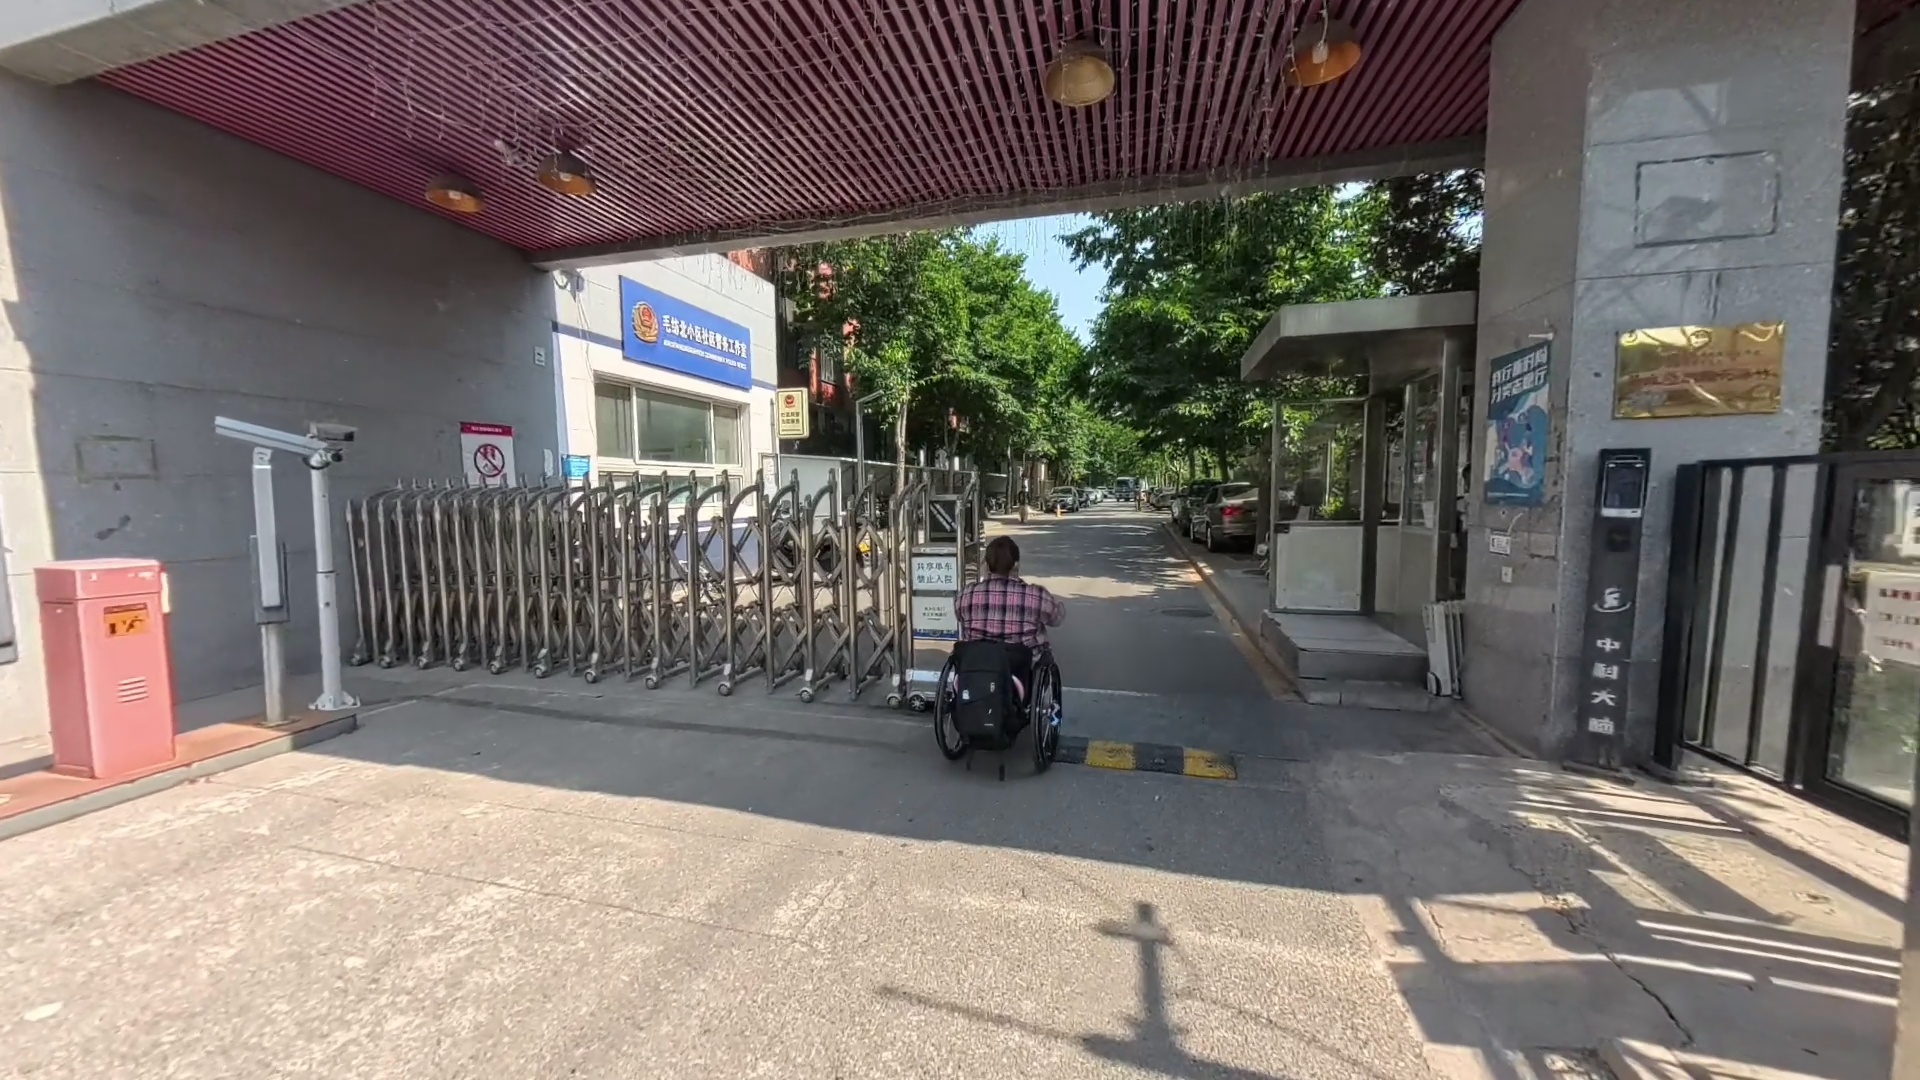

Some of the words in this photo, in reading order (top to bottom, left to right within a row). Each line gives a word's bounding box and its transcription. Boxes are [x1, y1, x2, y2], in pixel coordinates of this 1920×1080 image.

[661, 314, 748, 358] 毛纺北小区社区警务工作室
[916, 562, 953, 572] 共享单车
[916, 574, 953, 584] 禁止入院
